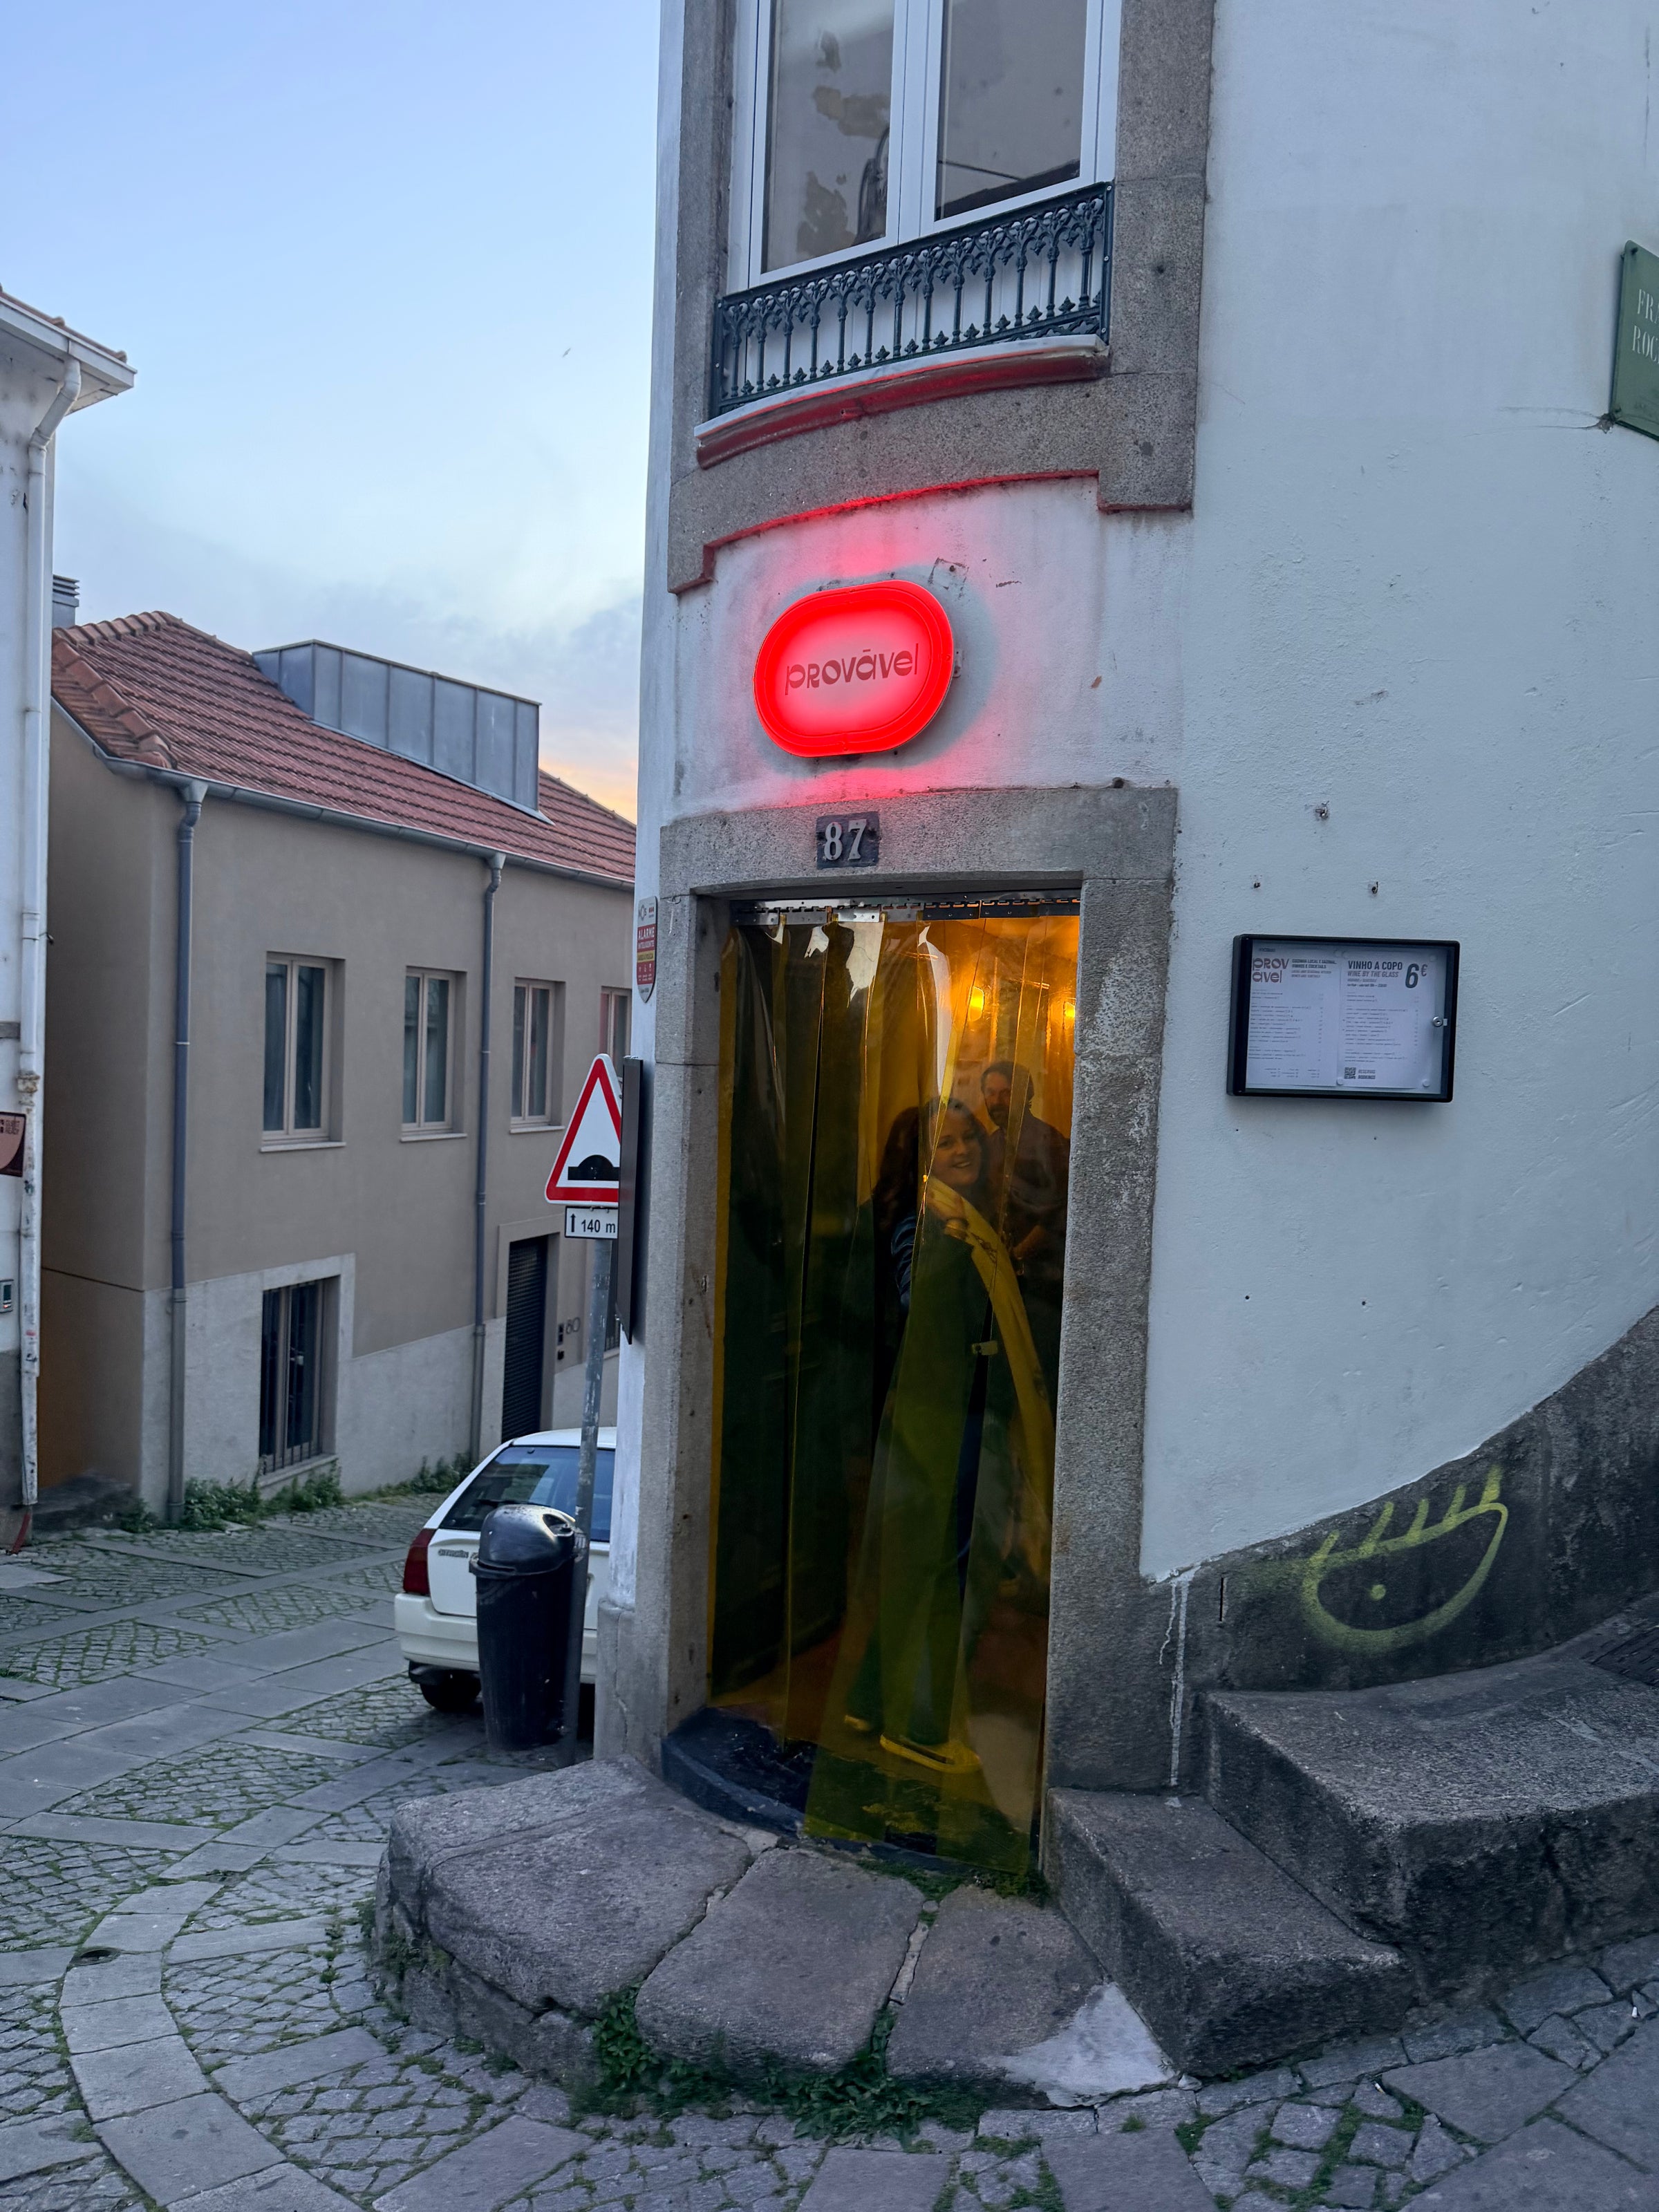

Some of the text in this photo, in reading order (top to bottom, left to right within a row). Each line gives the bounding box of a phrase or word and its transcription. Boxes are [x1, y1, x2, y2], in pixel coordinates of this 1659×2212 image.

[1632, 325, 1659, 364] ROC
[823, 818, 868, 861] 87
[638, 927, 655, 940] ALARME
[1348, 961, 1372, 970] VINHO
[1374, 962, 1380, 970] A
[1382, 962, 1403, 970] COPO
[581, 1219, 616, 1232] 140 m
